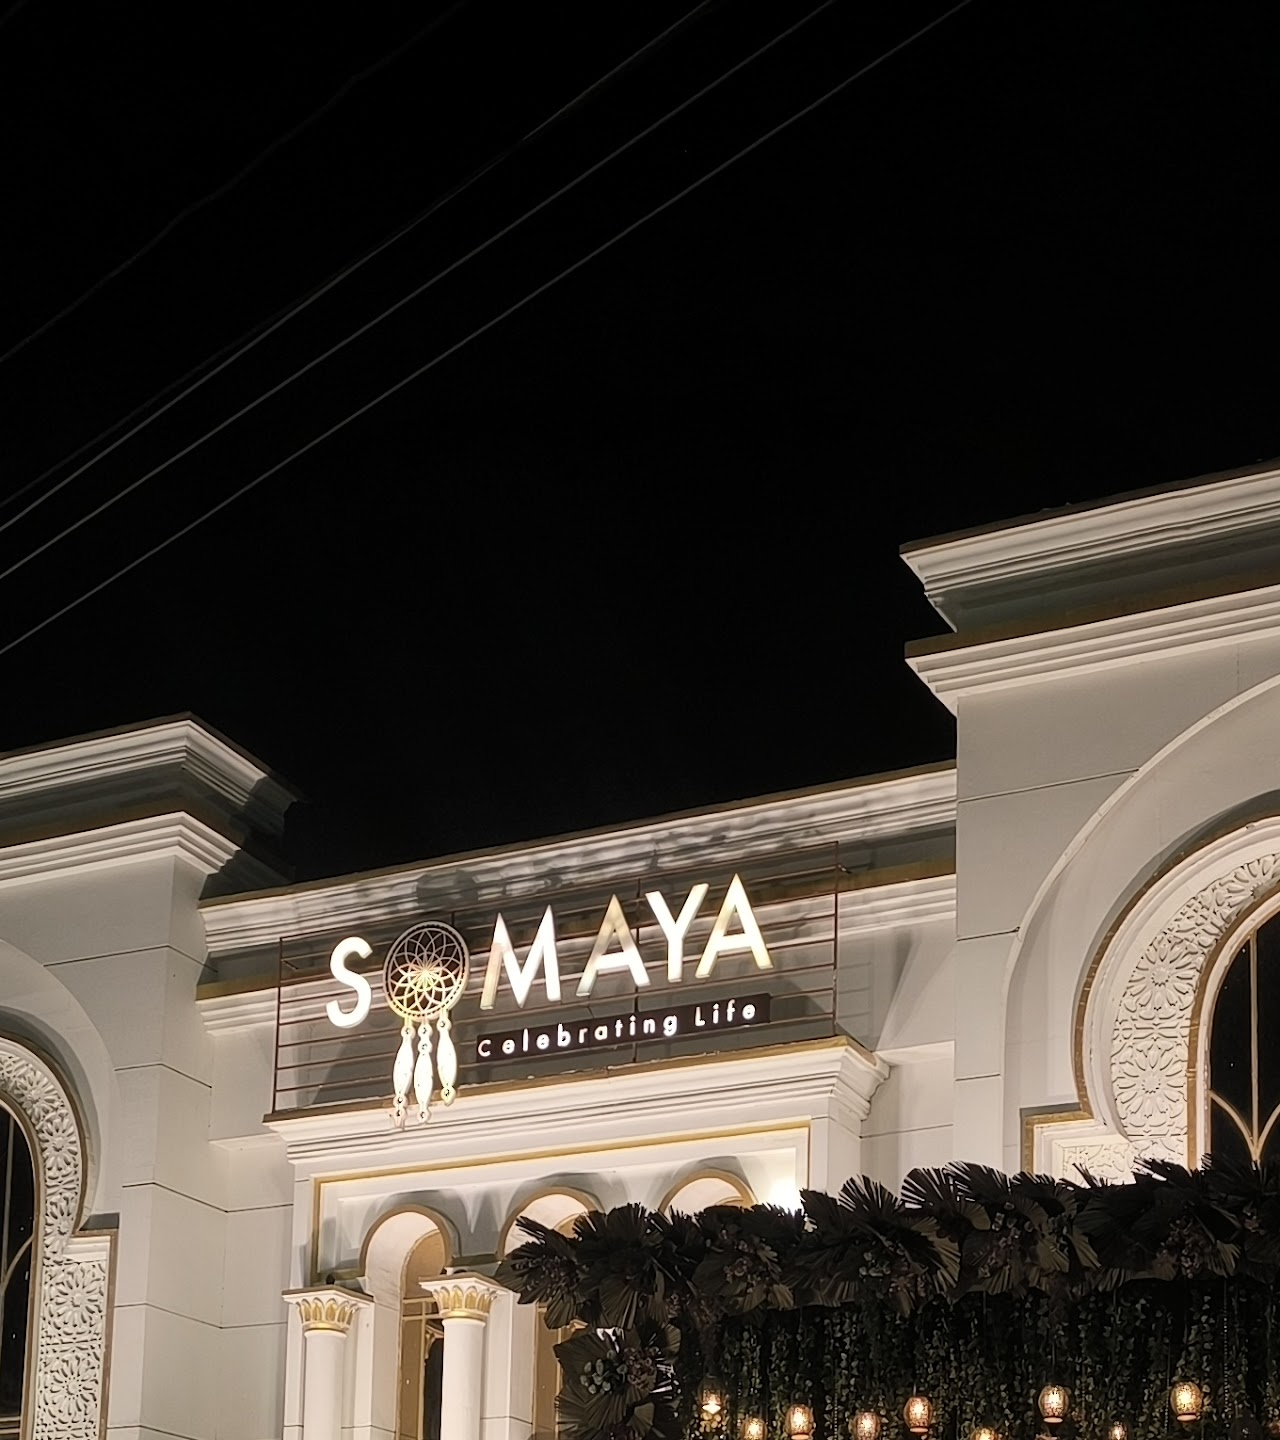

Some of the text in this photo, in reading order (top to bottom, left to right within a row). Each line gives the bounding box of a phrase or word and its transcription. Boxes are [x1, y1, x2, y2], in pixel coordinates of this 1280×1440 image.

[326, 873, 774, 1028] SOMAYA
[477, 999, 756, 1058] Celebrating Life
